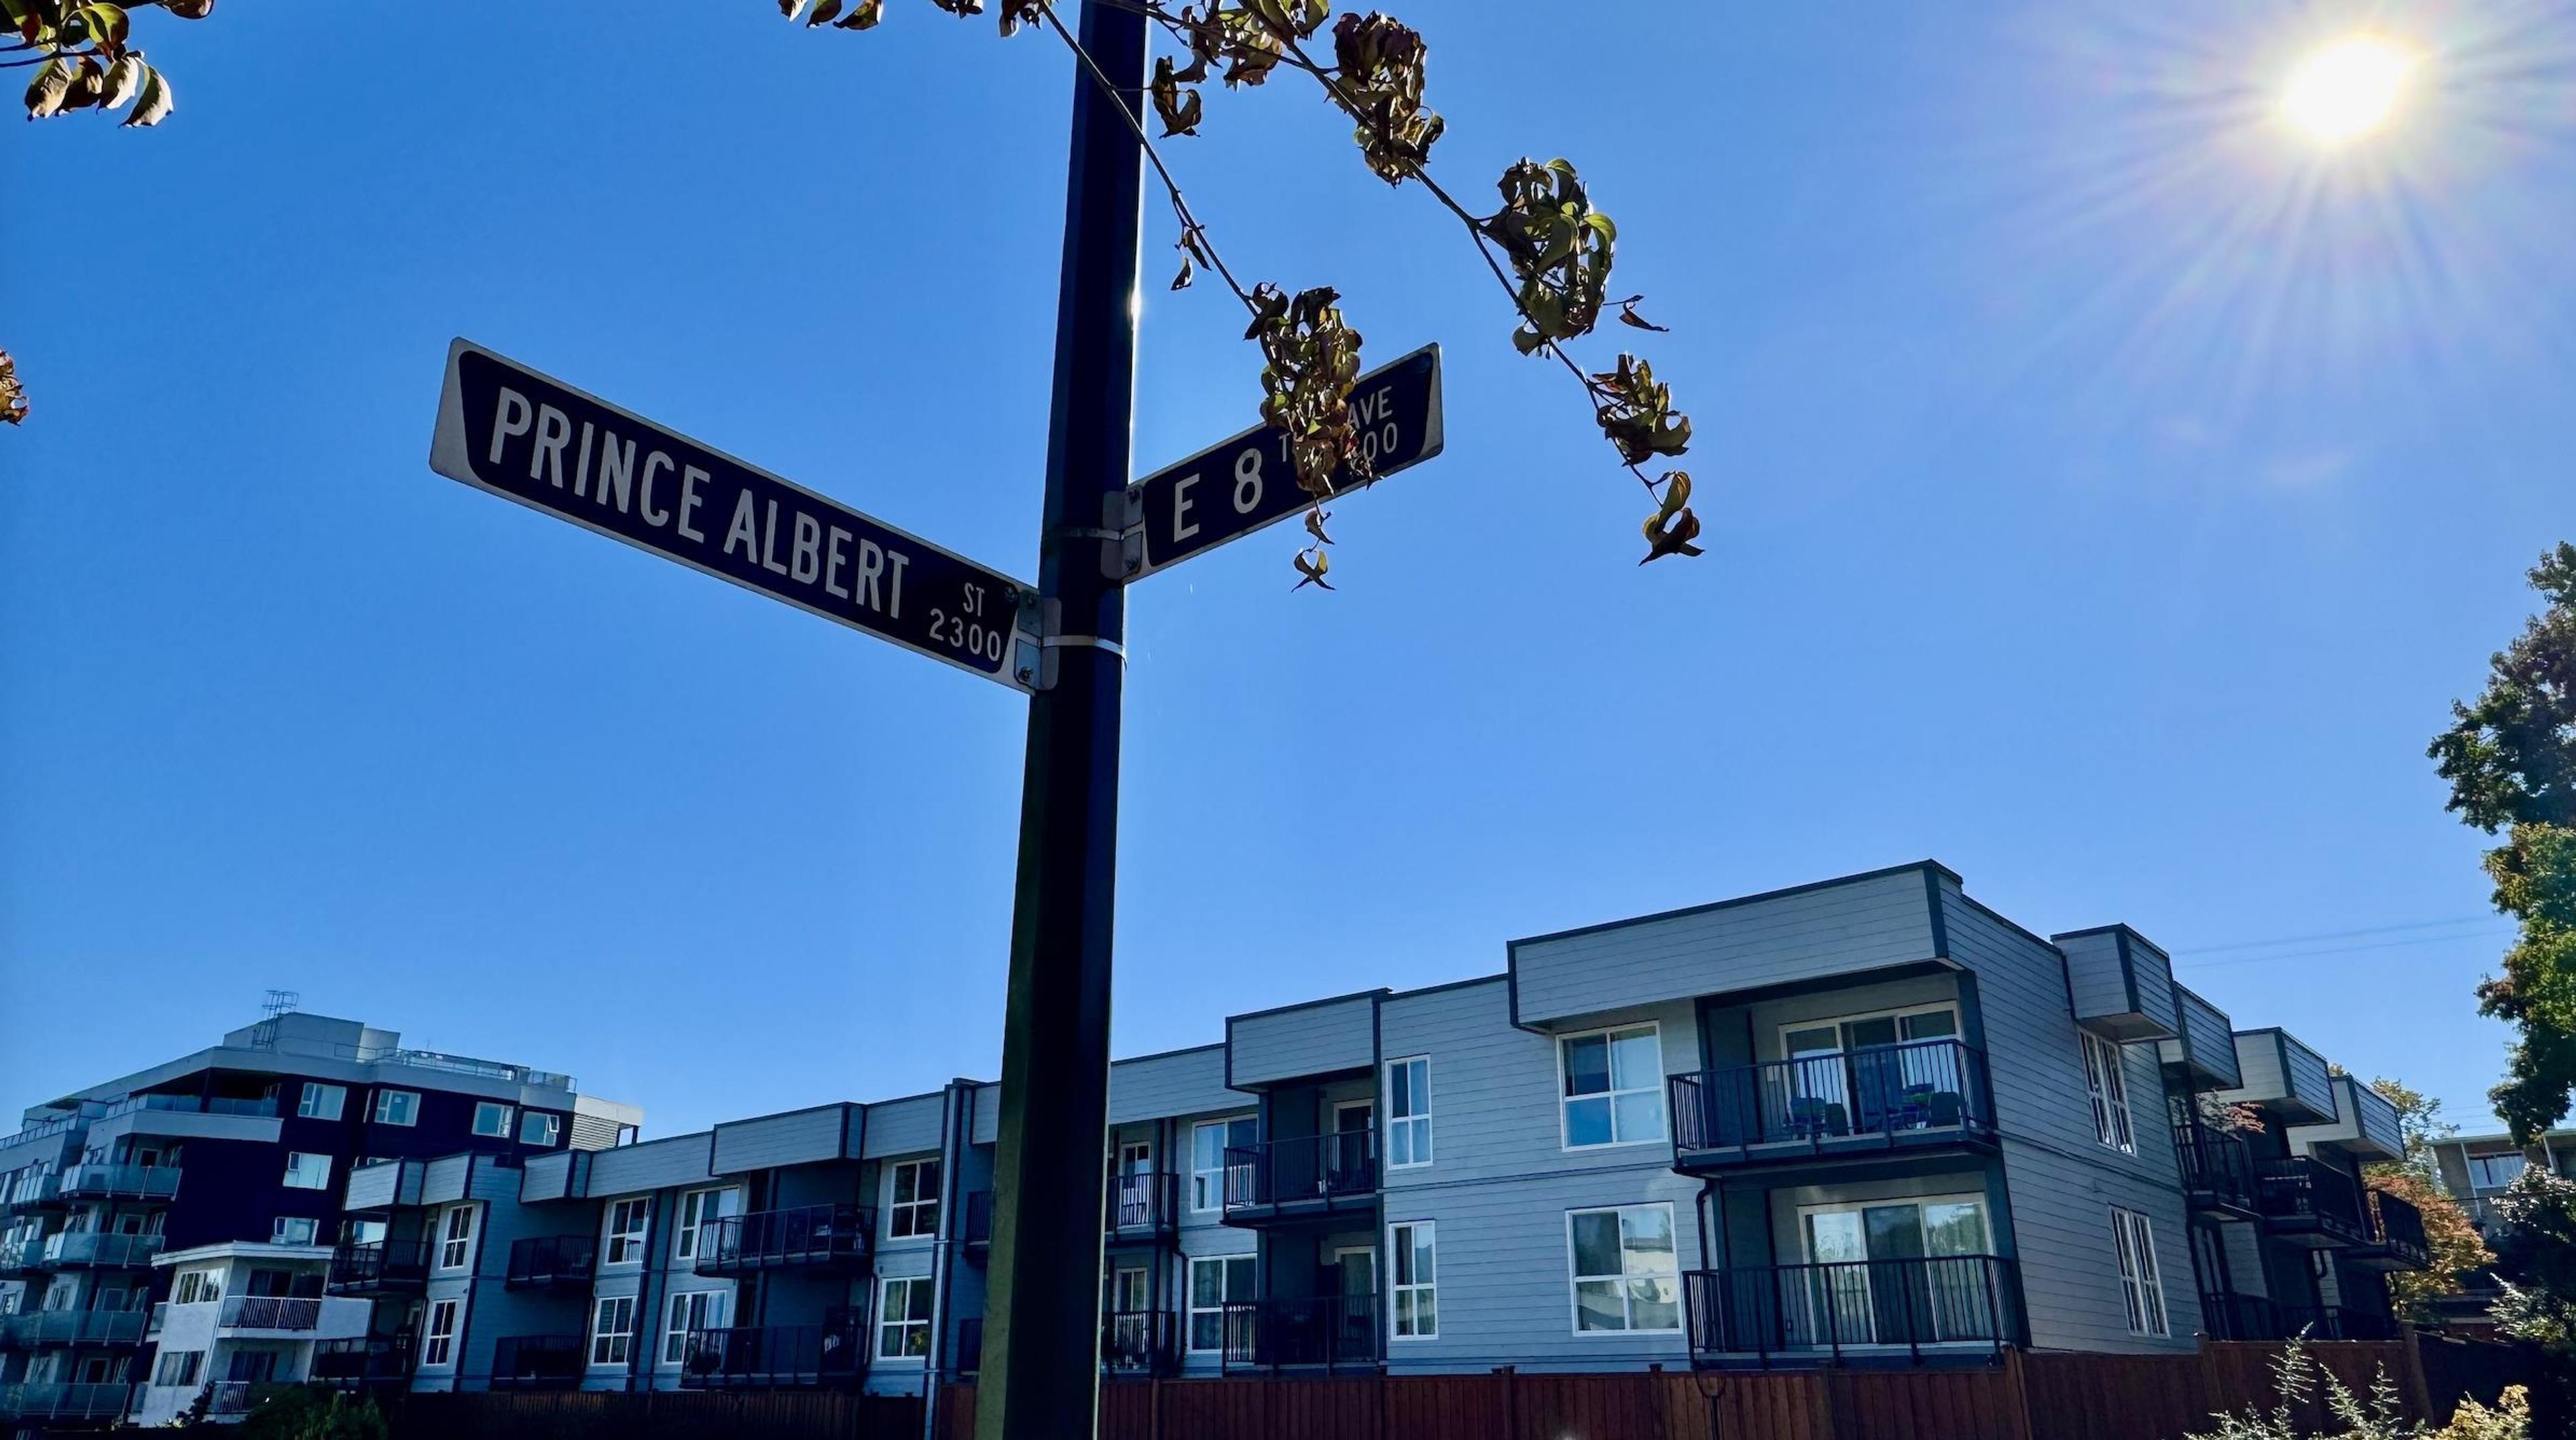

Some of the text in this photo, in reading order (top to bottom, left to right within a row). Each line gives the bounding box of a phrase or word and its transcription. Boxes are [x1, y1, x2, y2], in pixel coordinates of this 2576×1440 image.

[489, 386, 985, 620] PRINCE ALBERT ST
[1173, 473, 1200, 543] E
[1346, 386, 1393, 430] AVE
[929, 608, 1002, 662] 2300
